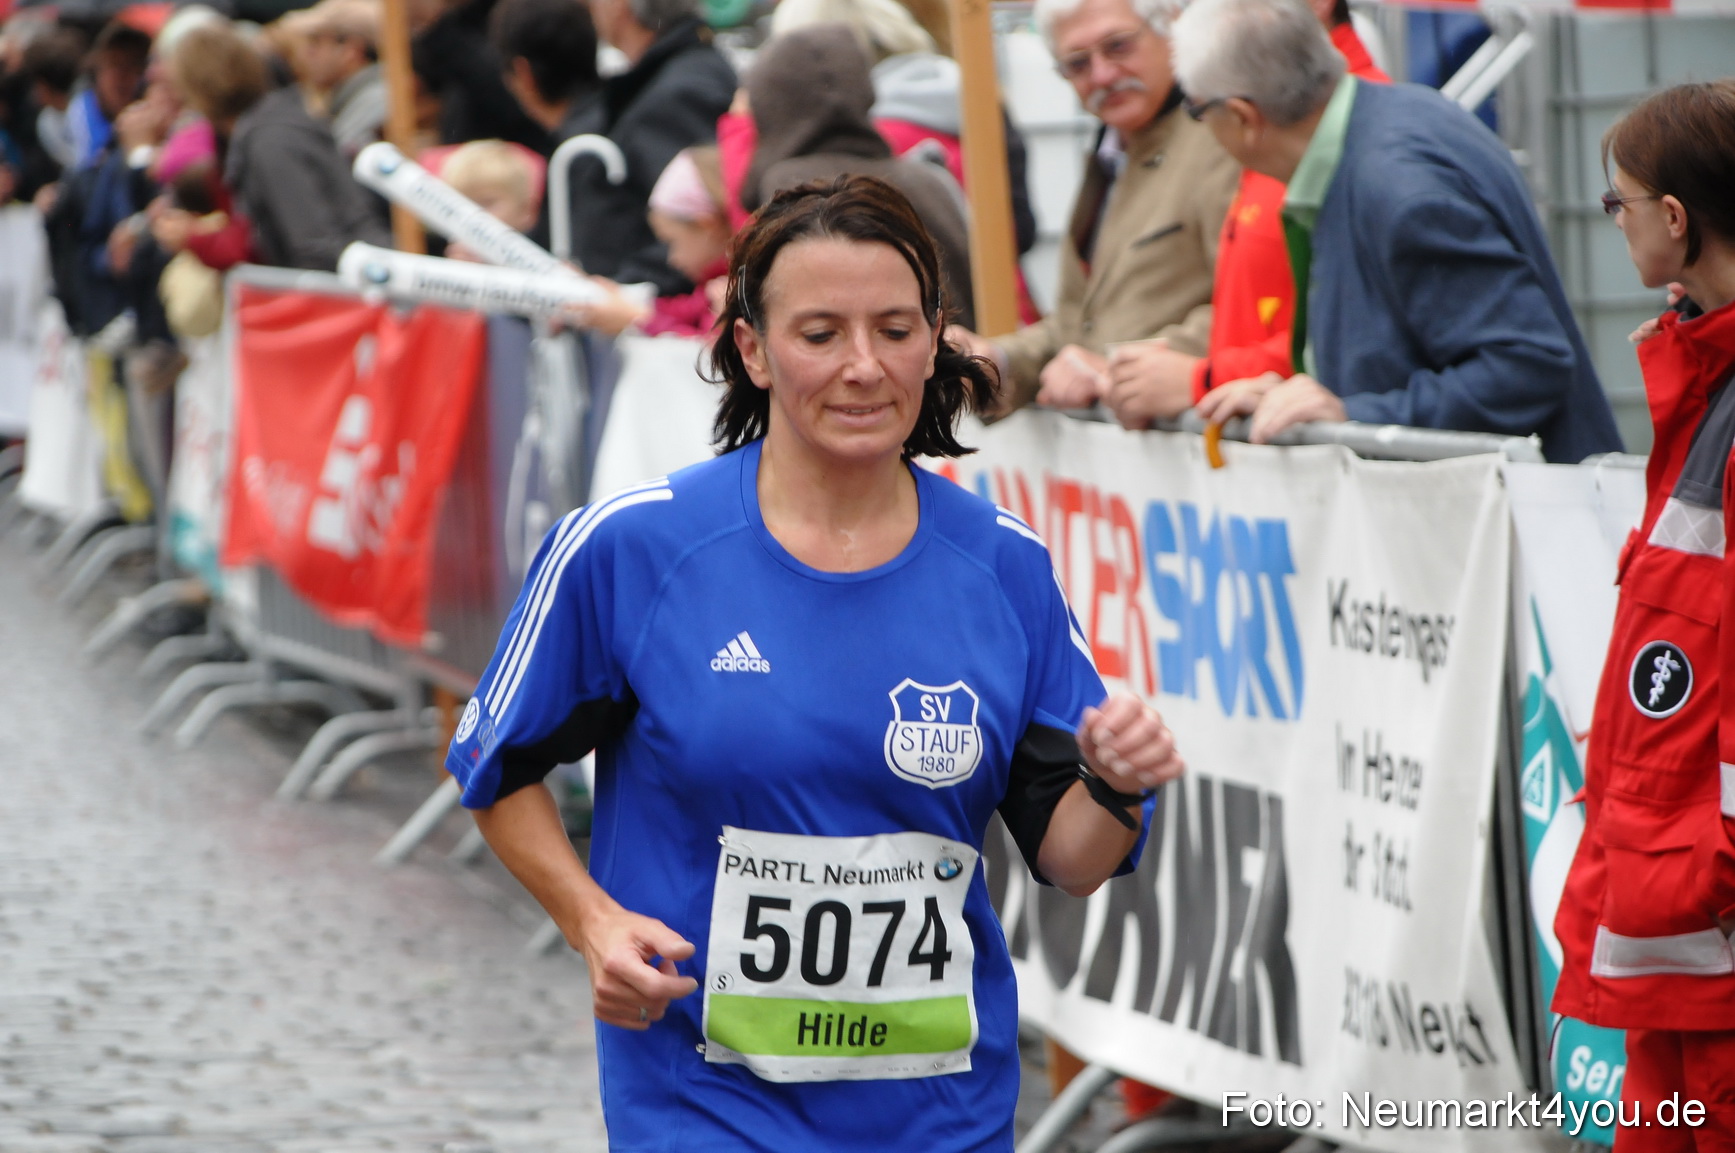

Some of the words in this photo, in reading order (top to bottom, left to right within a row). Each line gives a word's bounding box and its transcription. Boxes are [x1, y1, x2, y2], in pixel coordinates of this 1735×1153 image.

[710, 656, 771, 674] adidas
[920, 694, 951, 722] SV
[900, 726, 972, 755] STAUF
[917, 756, 955, 774] 1980
[723, 854, 816, 884] PARTL
[824, 861, 925, 886] Neumarkt
[739, 894, 953, 988] 5074
[797, 1012, 888, 1047] Hilde
